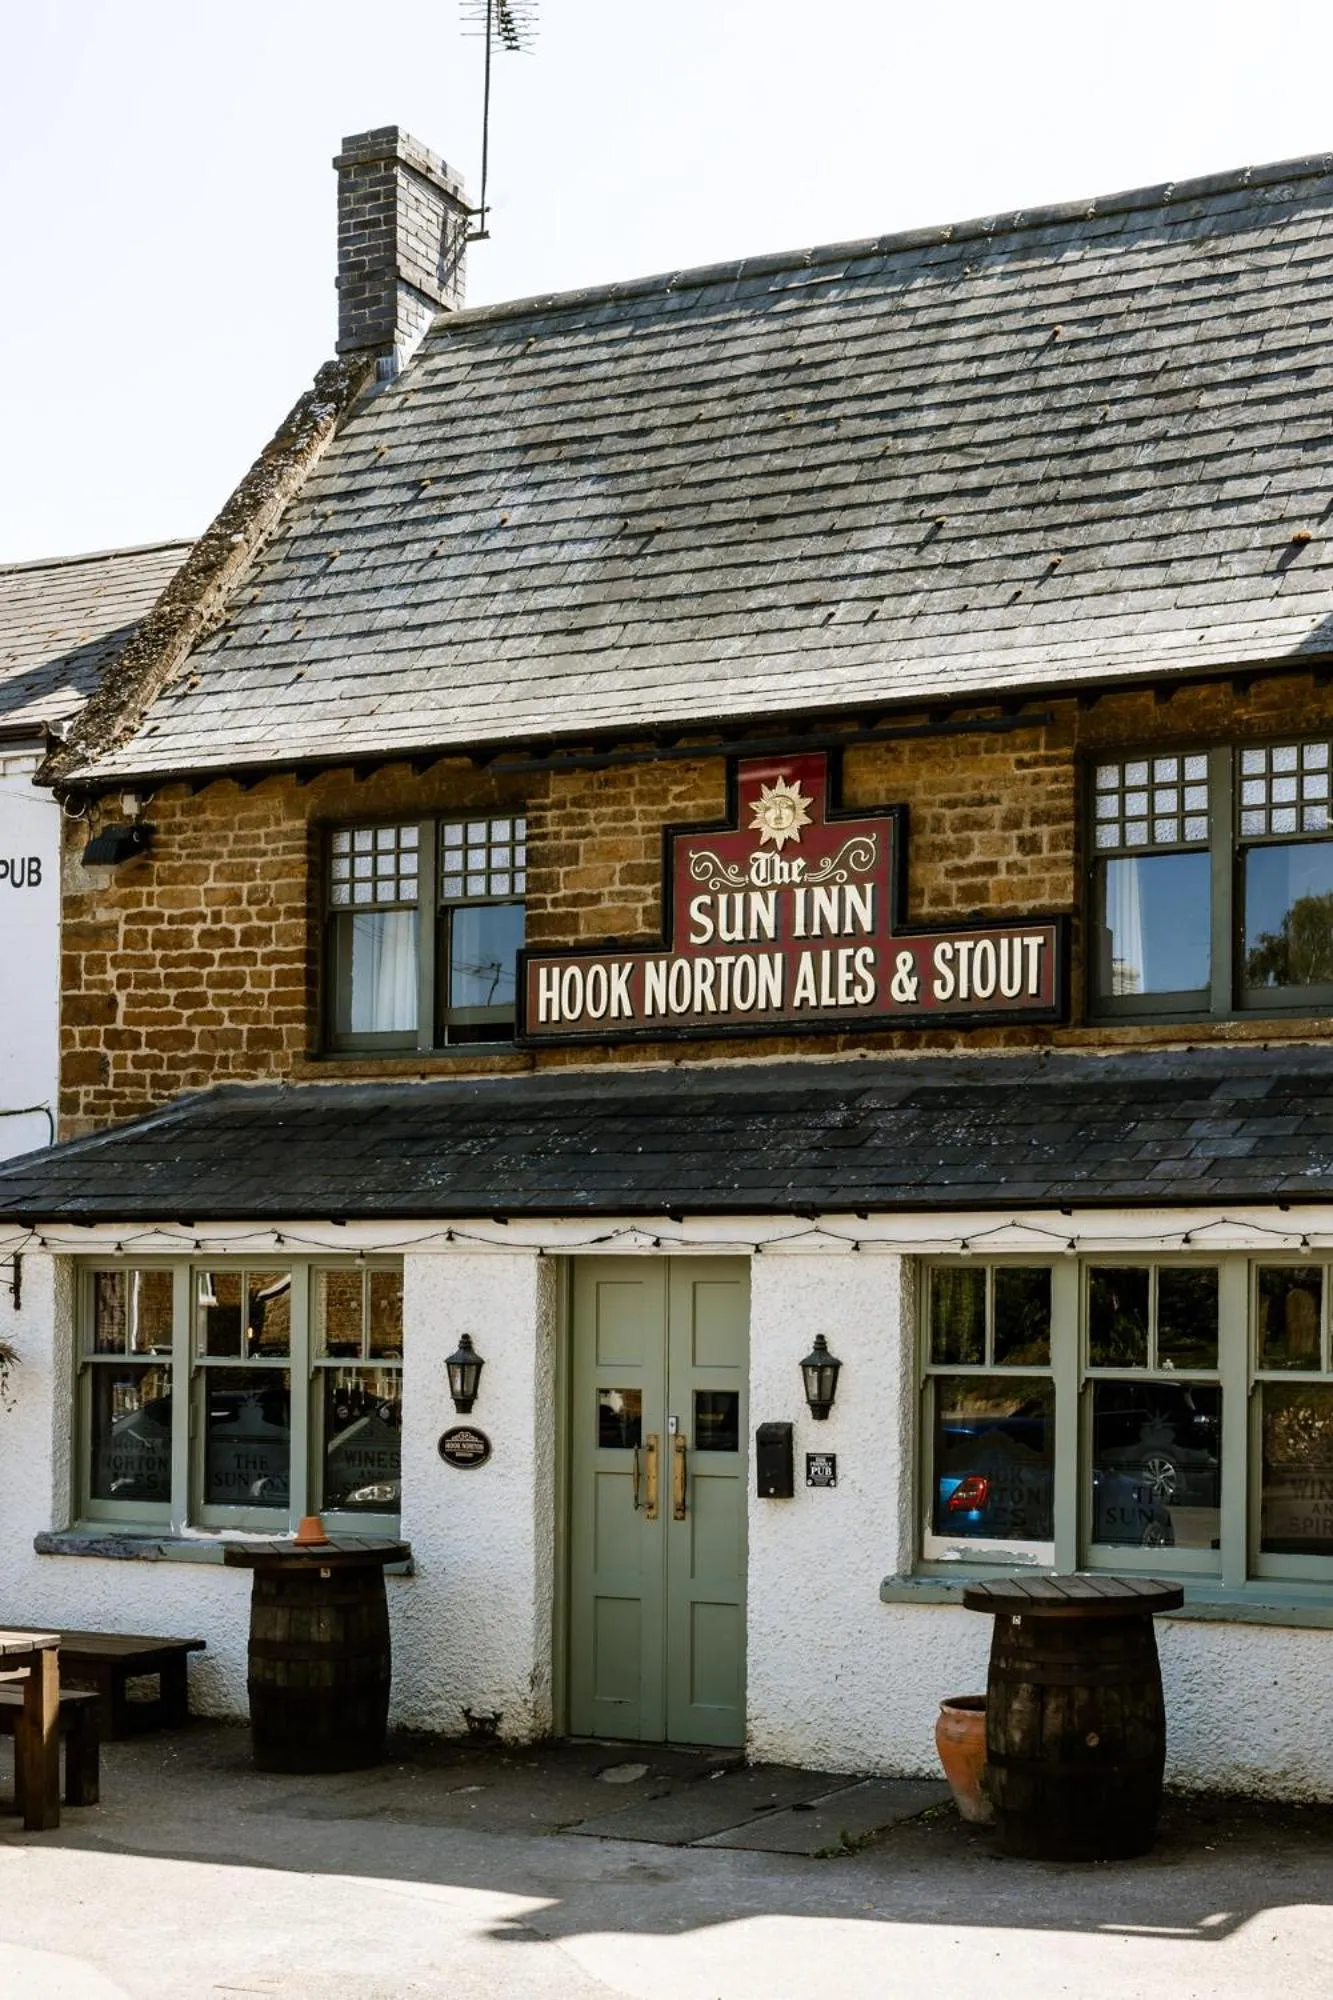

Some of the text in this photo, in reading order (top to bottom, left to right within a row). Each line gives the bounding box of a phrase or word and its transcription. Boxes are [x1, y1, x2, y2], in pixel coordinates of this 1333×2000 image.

[750, 850, 807, 887] The
[689, 883, 874, 944] SUN INN
[538, 936, 1045, 1023] HOOK NORTON ALES & STOUT
[234, 1454, 268, 1470] THE
[345, 1451, 401, 1468] WINES
[811, 1466, 832, 1476] PUB
[214, 1472, 249, 1488] SUN
[1105, 1507, 1154, 1524] SUN
